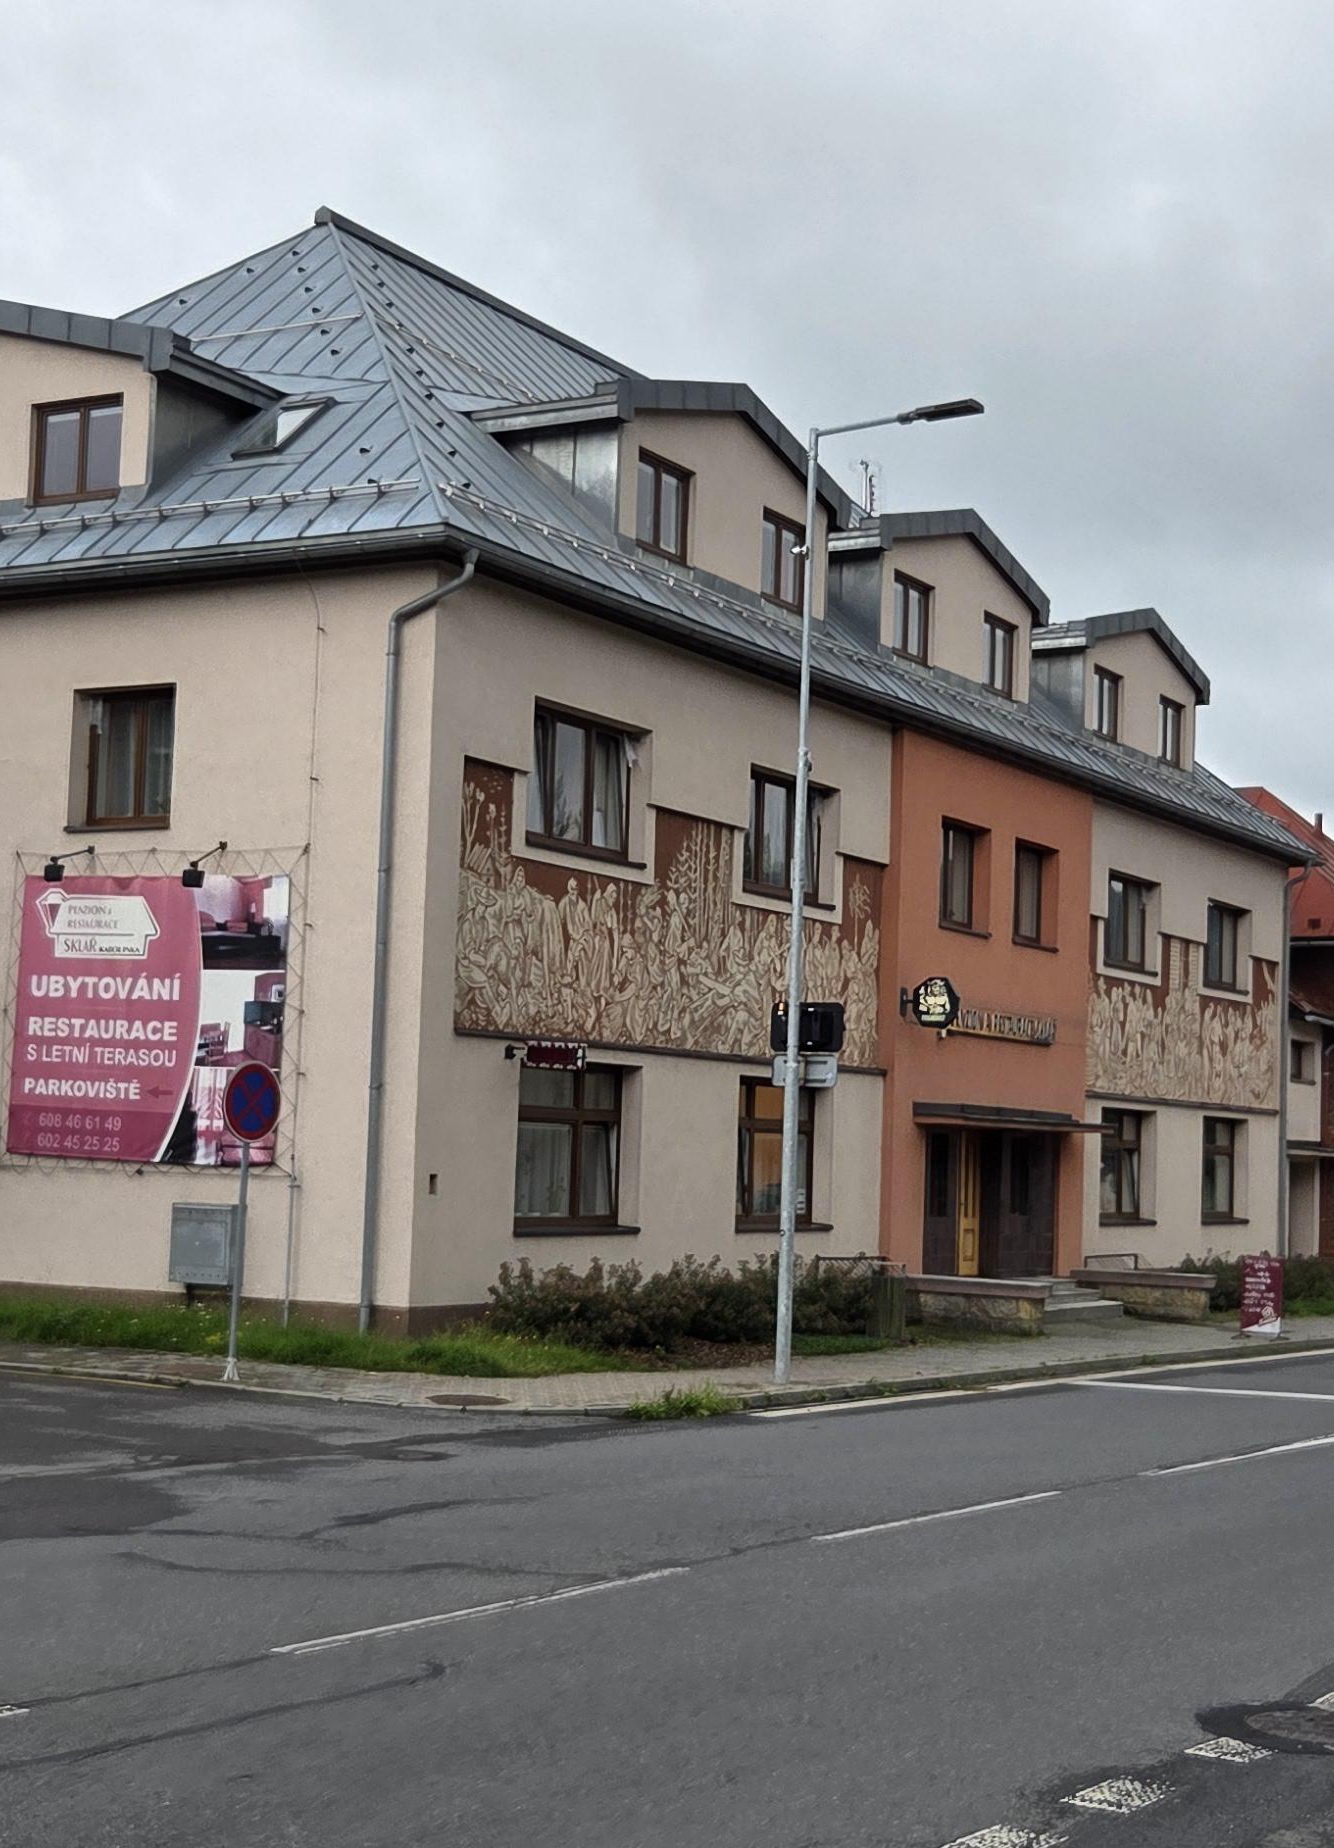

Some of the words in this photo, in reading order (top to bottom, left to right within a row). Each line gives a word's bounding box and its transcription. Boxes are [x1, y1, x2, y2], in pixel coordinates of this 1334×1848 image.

[30, 972, 182, 1001] UBYTOVÁNÍ
[27, 1016, 178, 1041] RESTAURACE
[26, 1043, 38, 1062] S
[42, 1042, 91, 1065] LETNÍ
[94, 1047, 178, 1068] TERASOU
[23, 1076, 142, 1100] PARKOVIŠTĚ
[38, 1112, 62, 1129] 608
[65, 1113, 83, 1130] 46
[85, 1115, 101, 1131] 61
[104, 1116, 123, 1132] 49
[37, 1132, 61, 1148] 602
[63, 1134, 81, 1150] 45
[83, 1135, 100, 1151] 25
[102, 1136, 121, 1153] 25
